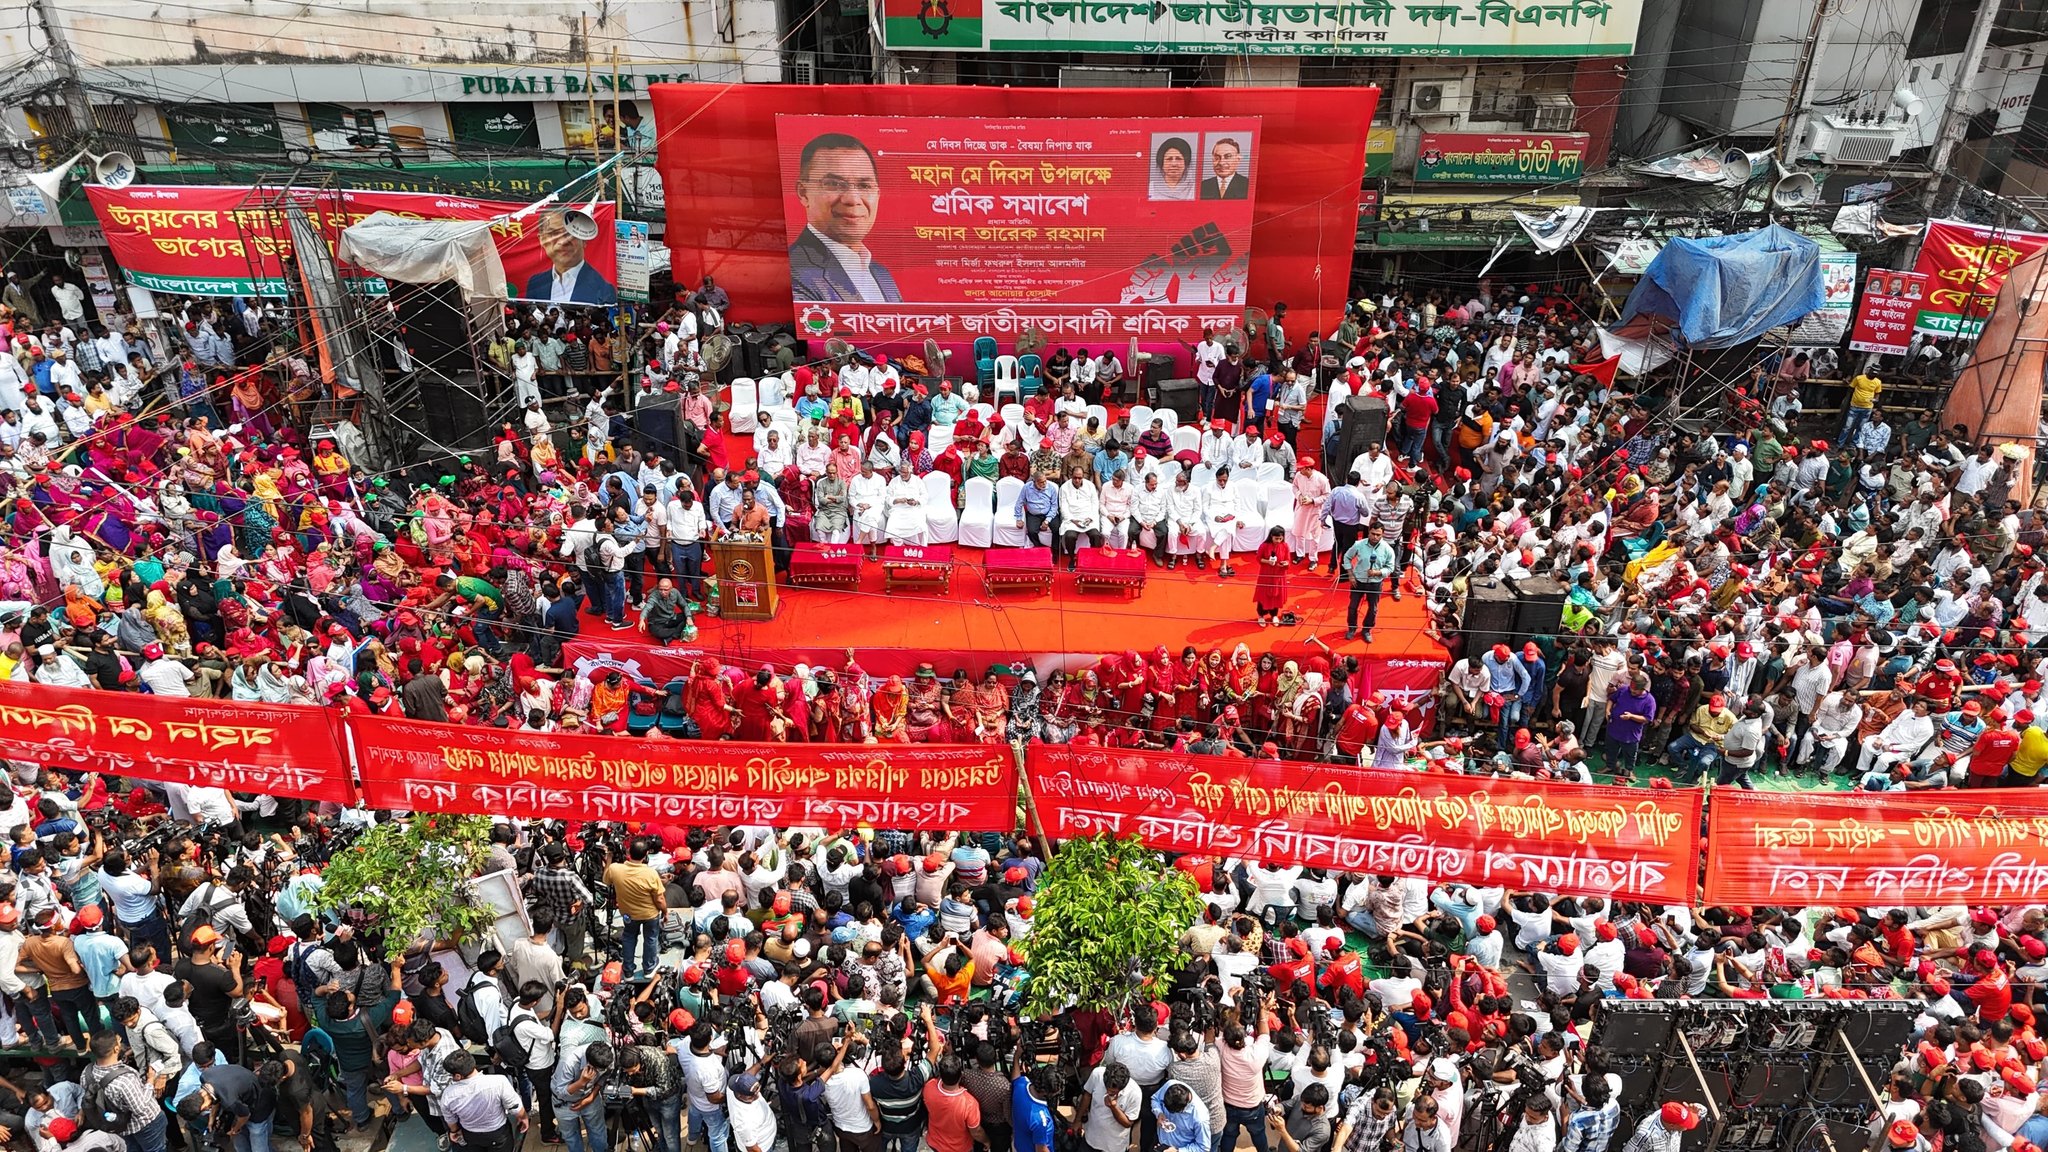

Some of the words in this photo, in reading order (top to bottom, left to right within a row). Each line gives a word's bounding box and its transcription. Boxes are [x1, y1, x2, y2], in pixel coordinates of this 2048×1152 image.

[996, 1, 1160, 25] বাংলাদেশ
[1223, 28, 1295, 42] কেন্দ্রীয়
[1306, 29, 1387, 42] কার্যালয়
[461, 76, 555, 94] PUBALI
[565, 74, 635, 93] BANK
[2000, 95, 2031, 109] HOTE
[1557, 149, 1581, 174] দল
[907, 164, 954, 187] মহান
[961, 165, 983, 184] মে
[988, 159, 1034, 186] দিবস
[1039, 160, 1113, 186] উপলক্ষে
[930, 188, 994, 216] শ্রমিক
[1003, 192, 1091, 216] সমাবেশ
[107, 203, 218, 235] উন্নয়নের
[914, 226, 968, 242] জনাব
[973, 226, 1039, 242] তারেক
[1044, 227, 1107, 242] রহমান
[152, 237, 246, 258] ভাগ্যের
[141, 276, 238, 294] বাংলাদেশ
[1869, 297, 1885, 307] সকল
[839, 312, 953, 334] বাংলাদেশ
[959, 309, 1114, 334] জাতীয়তাবাদী
[1121, 311, 1190, 335] শ্রমিক
[1890, 347, 1905, 355] দল
